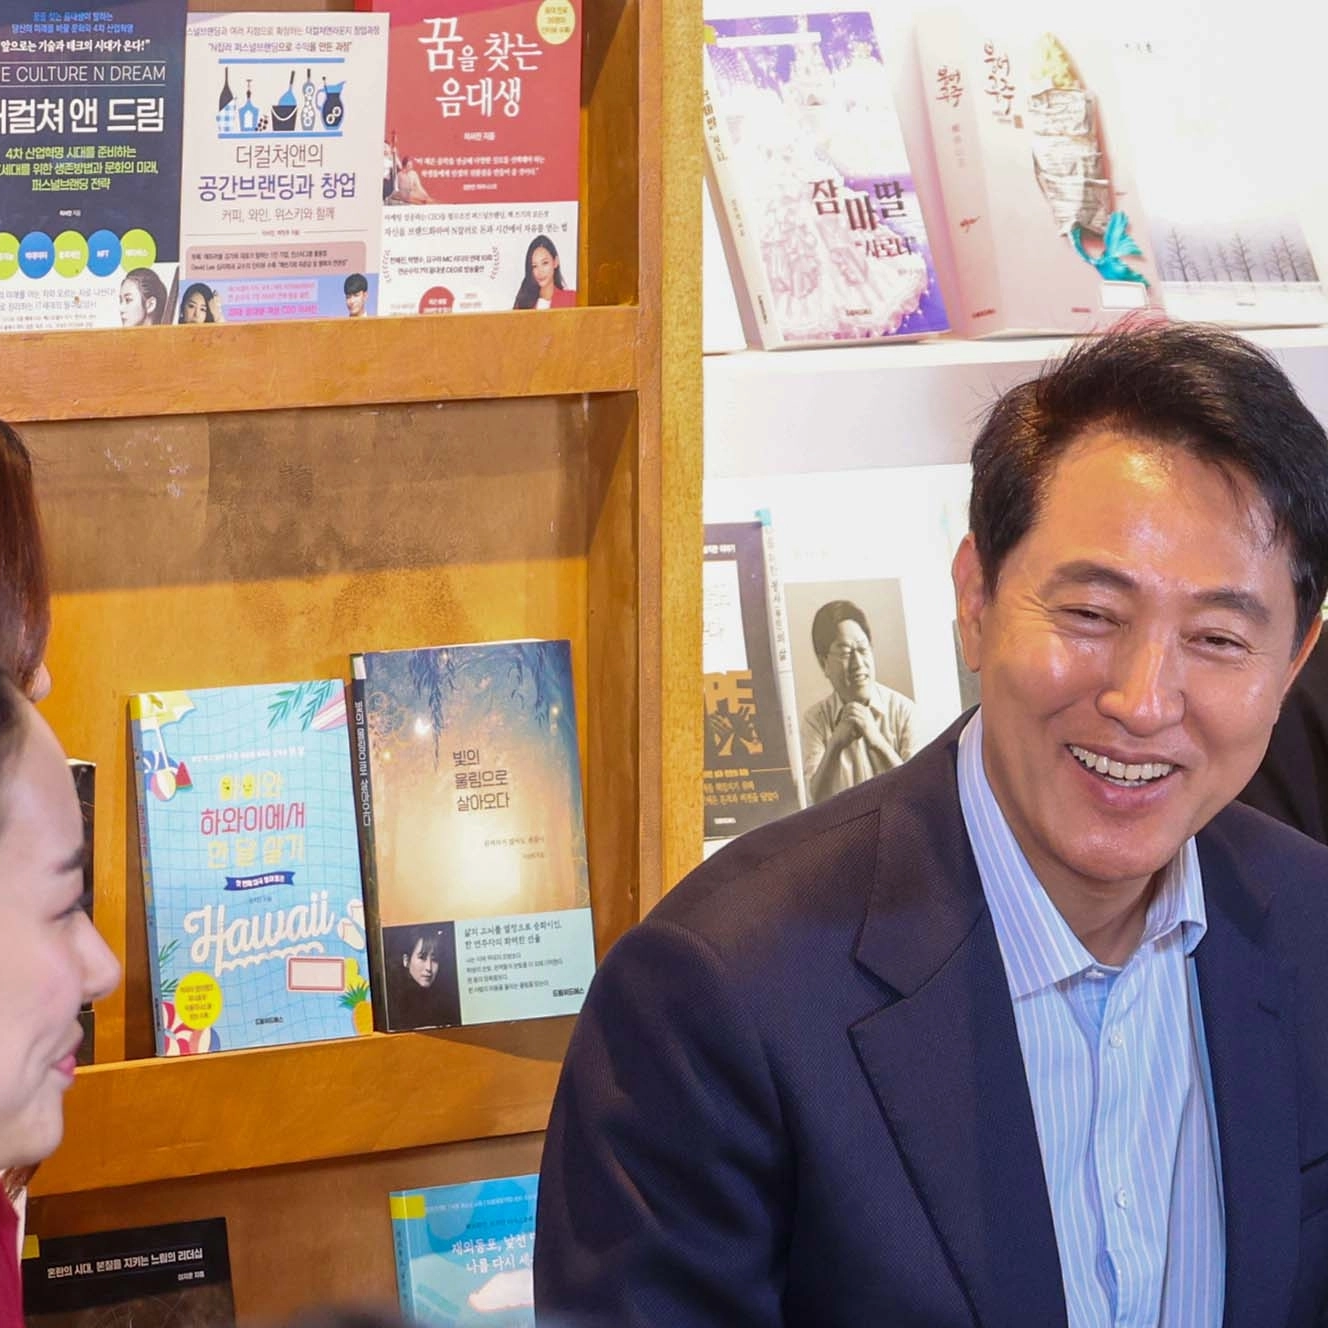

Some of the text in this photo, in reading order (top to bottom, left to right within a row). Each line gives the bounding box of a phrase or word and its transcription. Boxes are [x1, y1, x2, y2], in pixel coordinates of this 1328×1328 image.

[186, 26, 227, 36] 스널브랜딩과
[418, 17, 543, 72] 꿈을 찾는
[16, 65, 88, 82] CULTURE
[93, 66, 105, 81] N
[110, 65, 166, 81] DREAM
[435, 77, 521, 118] 음대생
[70, 98, 98, 132] 앤
[107, 97, 164, 132] 드림
[6, 146, 137, 160] 4차 산업혁명 시대를 준비하는
[236, 144, 324, 169] 더컬쳐앤의
[32, 163, 52, 175] 위한
[198, 172, 356, 201] 공간브랜딩과 창업
[221, 209, 245, 223] 커피,
[275, 207, 313, 221] 위스키와
[316, 206, 335, 219] 함께
[453, 749, 480, 768] 빛의
[455, 769, 509, 790] 울림으로
[457, 791, 510, 812] 살아오다
[201, 802, 305, 835] 하와이에서
[235, 837, 258, 868] 달
[263, 835, 305, 865] 살기
[184, 890, 336, 977] Hawaii
[123, 1255, 149, 1268] 지키는
[178, 1248, 203, 1261] 리더십
[492, 1254, 515, 1269] 다시
